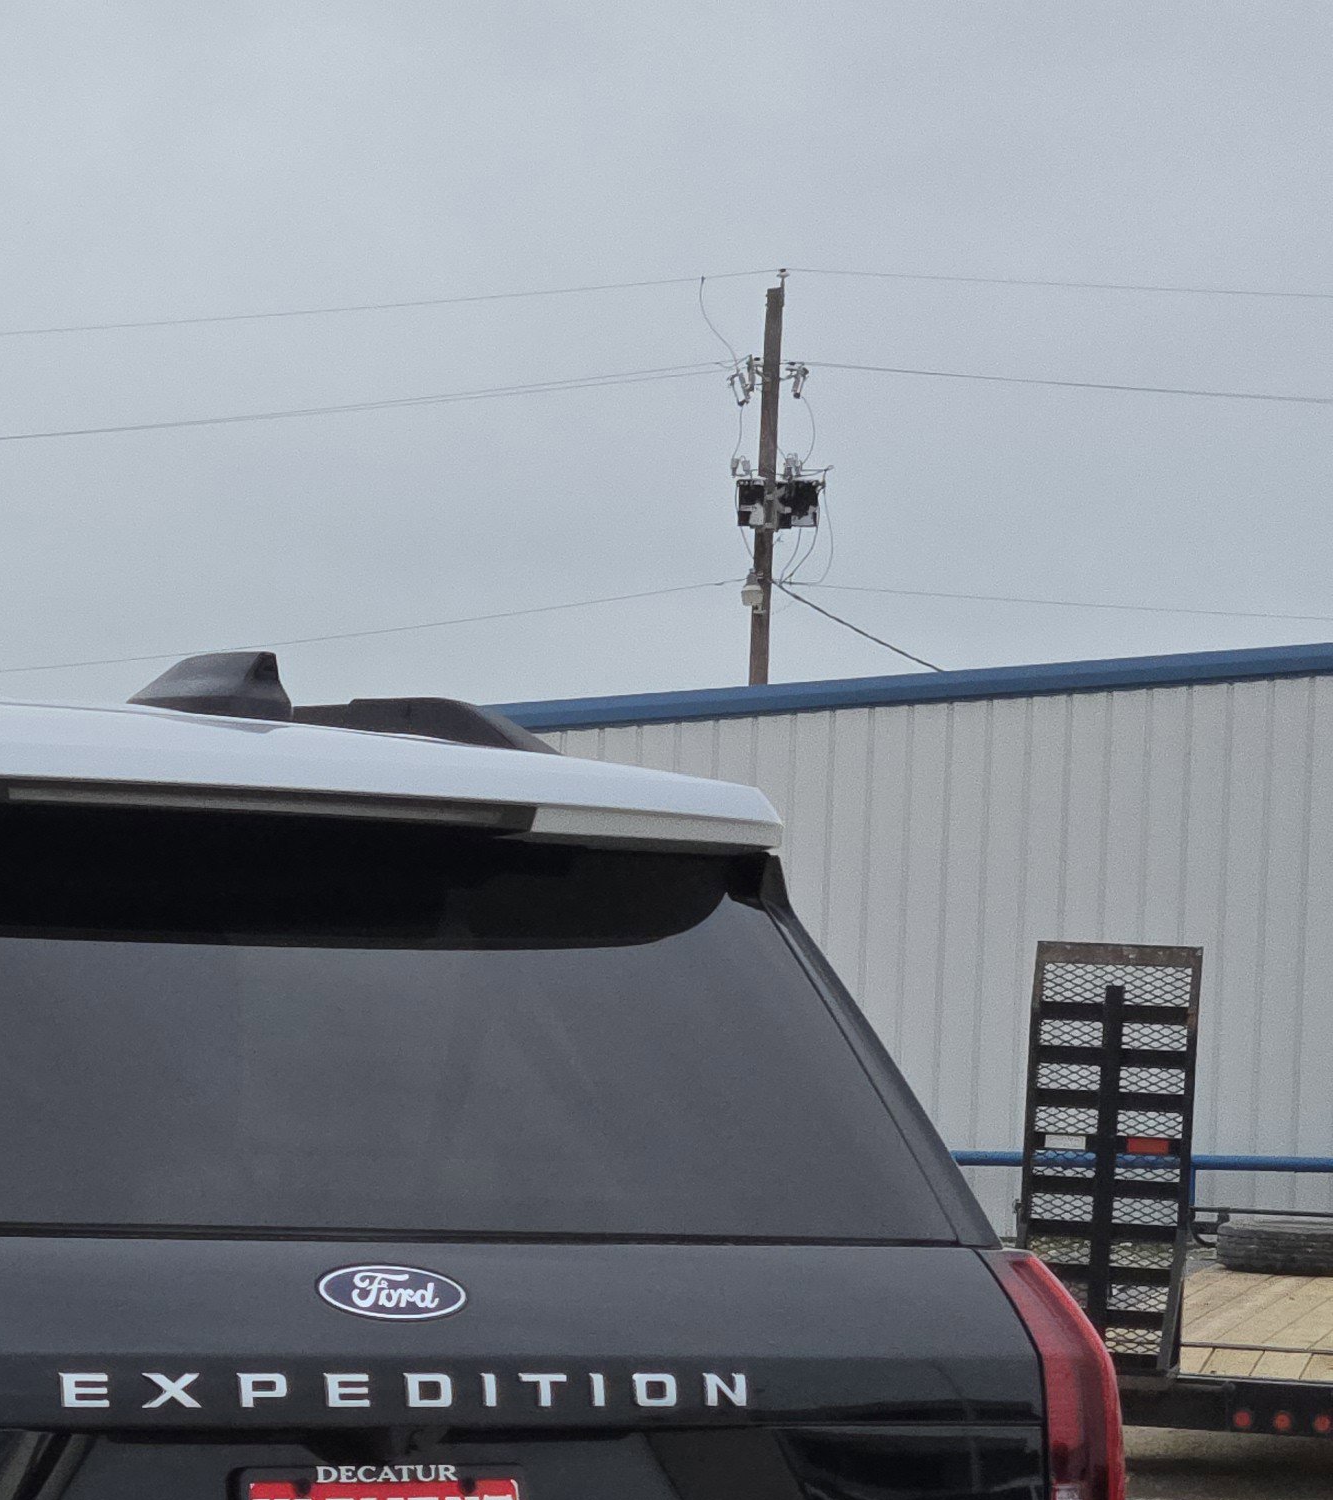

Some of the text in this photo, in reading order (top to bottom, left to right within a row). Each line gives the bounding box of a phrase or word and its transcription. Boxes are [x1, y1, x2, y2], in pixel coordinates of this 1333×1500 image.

[351, 1271, 440, 1309] Ford
[58, 1371, 747, 1409] EXPEDITION
[315, 1464, 458, 1483] DECATUR
